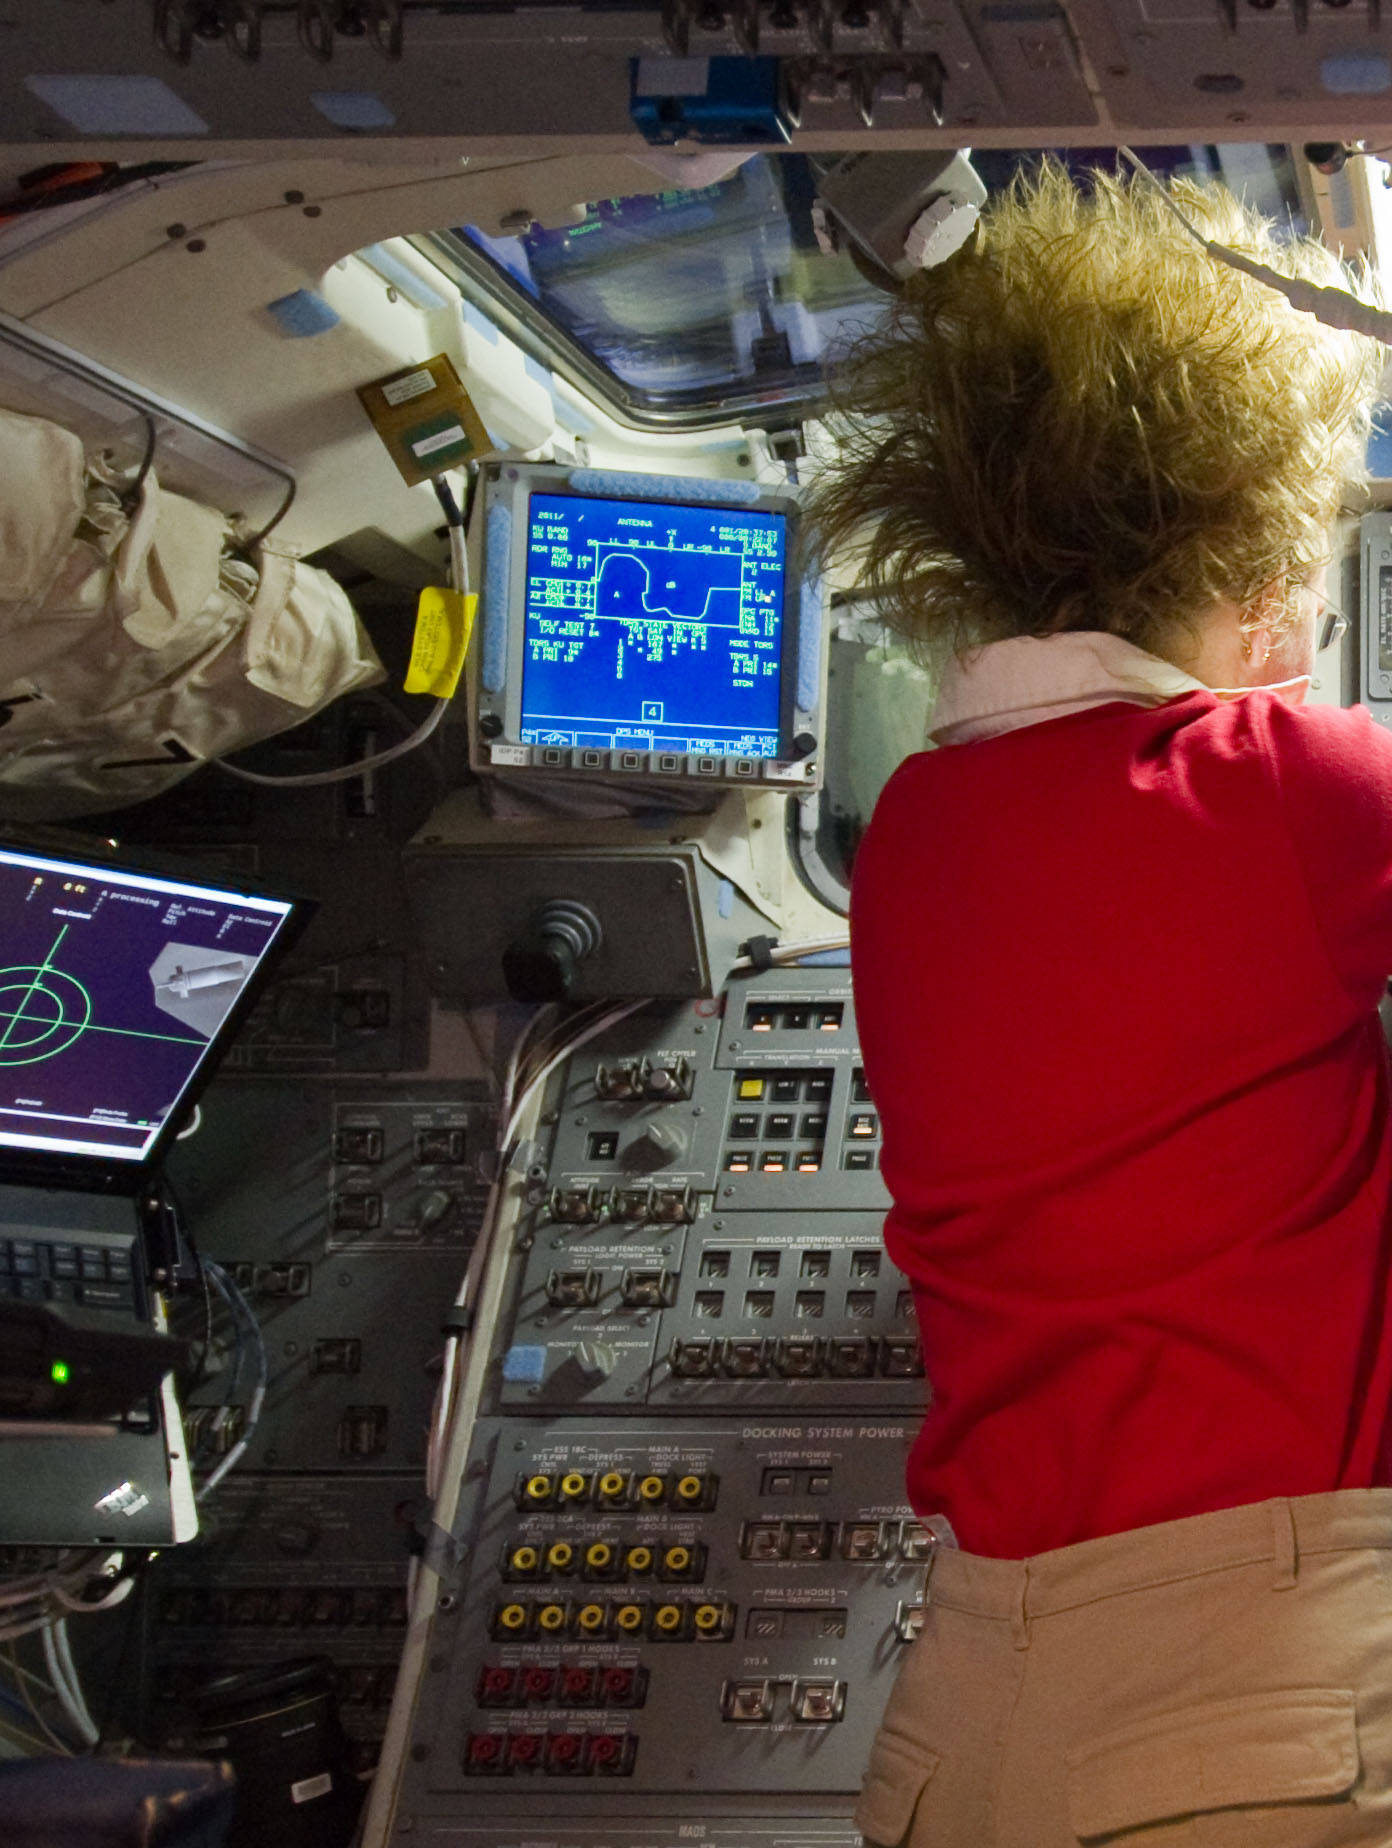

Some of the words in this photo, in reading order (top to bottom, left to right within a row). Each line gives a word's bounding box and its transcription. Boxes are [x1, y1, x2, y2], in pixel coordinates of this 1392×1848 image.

[742, 1428, 801, 1438] DOCKING
[807, 1428, 853, 1438] SYSTEM
[858, 1428, 904, 1438] POWER
[670, 1523, 695, 1531] LIGHT
